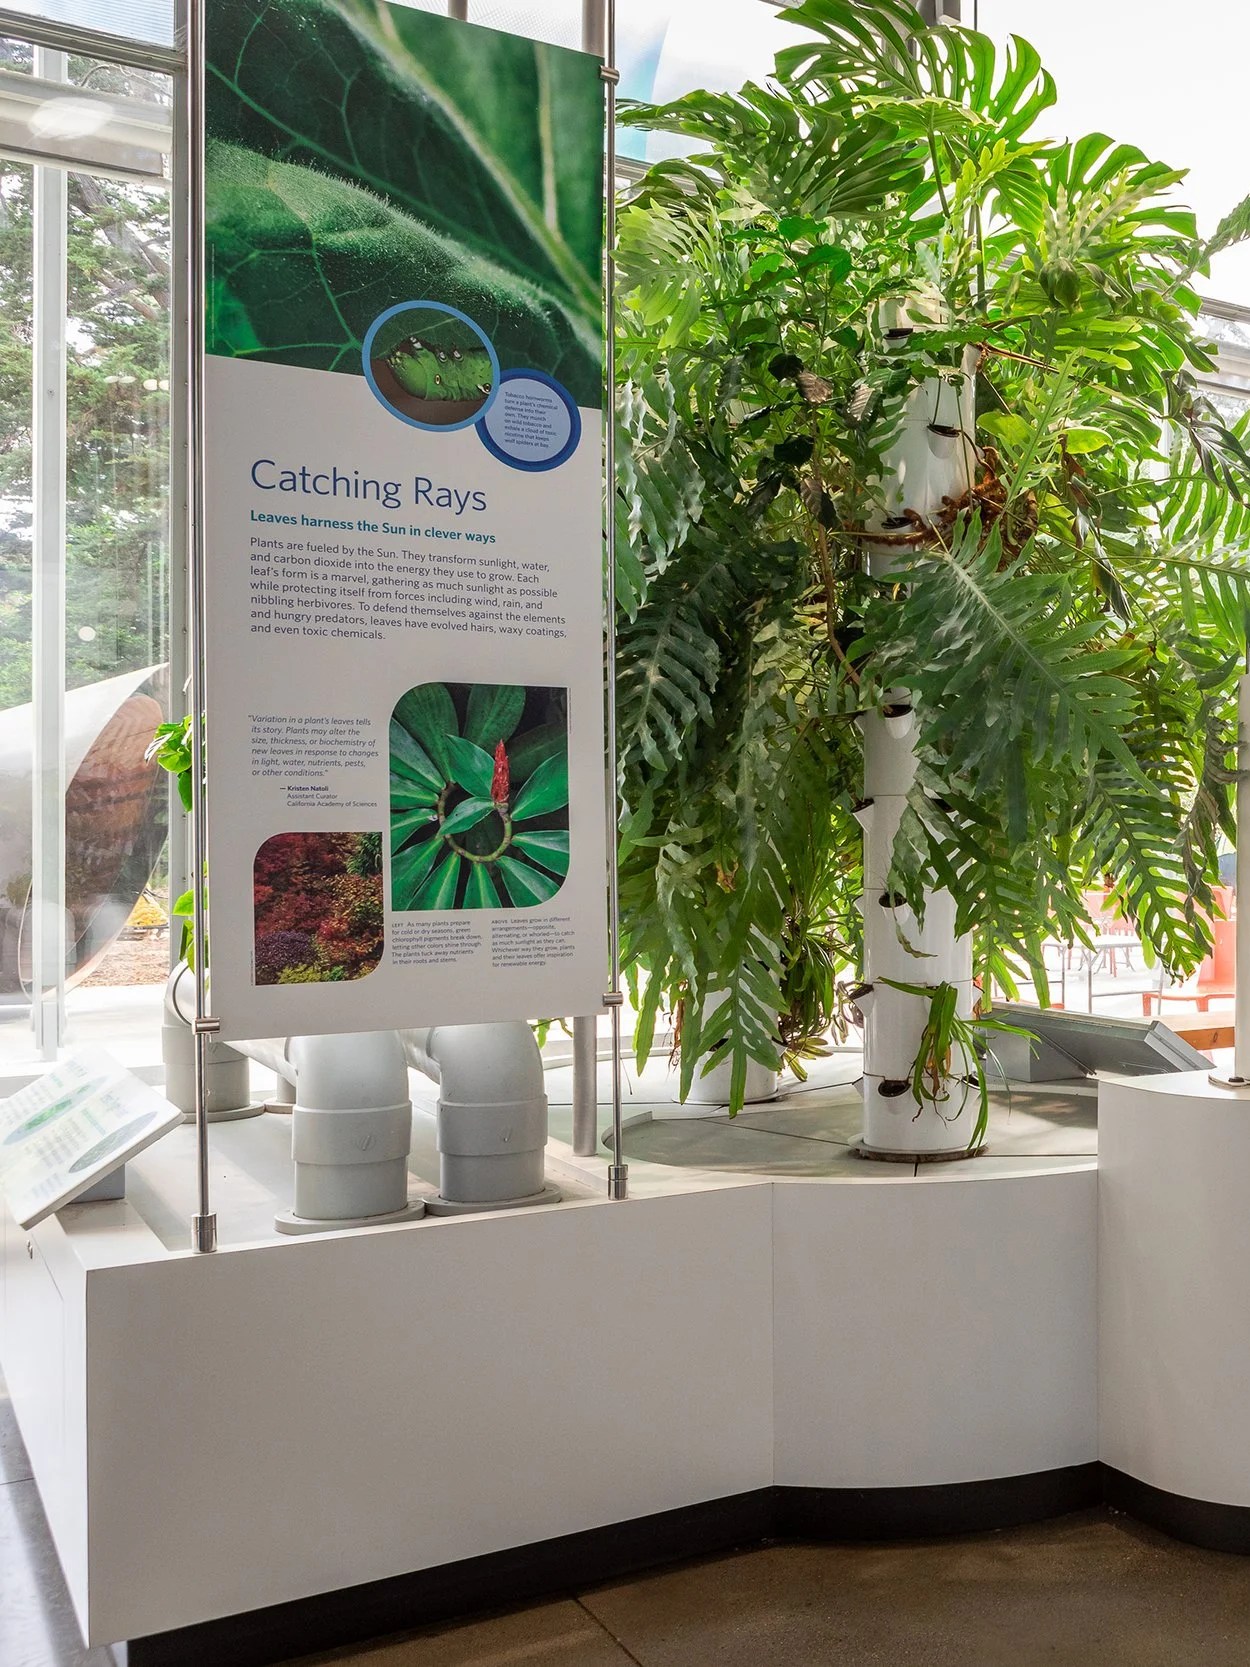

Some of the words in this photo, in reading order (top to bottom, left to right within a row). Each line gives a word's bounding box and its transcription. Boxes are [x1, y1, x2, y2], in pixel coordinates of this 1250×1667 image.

[251, 459, 402, 509] Catching
[414, 476, 487, 515] Rays
[251, 510, 297, 524] Leaves
[302, 514, 354, 530] harness
[357, 519, 378, 532] the
[382, 522, 406, 535] Sun
[410, 524, 421, 536] in
[425, 526, 462, 540] clever
[465, 533, 495, 547] ways
[250, 536, 284, 549] Plants
[287, 542, 304, 550] are
[307, 540, 339, 553] fueled
[342, 543, 354, 558] by
[358, 545, 374, 556] the
[377, 546, 398, 559] Sun.
[402, 549, 426, 564] They
[429, 551, 476, 565] transform
[479, 556, 519, 572] sunlight,
[522, 560, 549, 574] water,
[250, 551, 270, 562] and
[274, 553, 311, 565] carbon
[314, 555, 352, 568] dioxide
[355, 558, 374, 570] into
[377, 560, 394, 572] the
[396, 566, 430, 578] energy
[433, 565, 454, 580] they
[457, 570, 474, 578] use
[477, 568, 487, 580] to
[488, 573, 514, 584] grow.
[517, 572, 539, 584] Each
[250, 579, 279, 591] while
[282, 582, 337, 599] protecting
[340, 585, 365, 597] itself
[368, 587, 392, 599] from
[394, 589, 425, 602] forces
[428, 591, 472, 608] including
[474, 595, 500, 609] wind,
[503, 597, 523, 610] rain,
[526, 599, 542, 610] and
[251, 564, 279, 577] leaf's
[282, 567, 308, 579] form
[311, 569, 319, 580] is
[331, 573, 369, 586] marvel,
[372, 574, 420, 591] gathering
[436, 580, 464, 591] much
[465, 582, 504, 597] sunlight
[520, 586, 557, 599] possible
[251, 593, 294, 610] nibbling
[297, 596, 355, 610] herbivores.
[358, 600, 370, 611] To
[372, 601, 408, 614] defend
[410, 603, 466, 618] themselves
[469, 608, 503, 622] against
[506, 610, 521, 621] the
[523, 611, 565, 624] elements
[251, 608, 271, 619] and
[274, 608, 312, 625] hungry
[315, 612, 367, 627] predators,
[370, 615, 402, 627] leaves
[405, 617, 428, 629] have
[431, 620, 468, 631] evolved
[471, 621, 496, 635] hairs,
[499, 627, 523, 638] waxy
[526, 626, 566, 641] coatings,
[251, 622, 271, 633] and
[274, 626, 299, 634] even
[302, 624, 328, 636] toxic
[331, 626, 385, 640] chemicals.
[319, 738, 367, 748] biochemistry
[368, 739, 376, 748] of
[348, 749, 379, 759] changes
